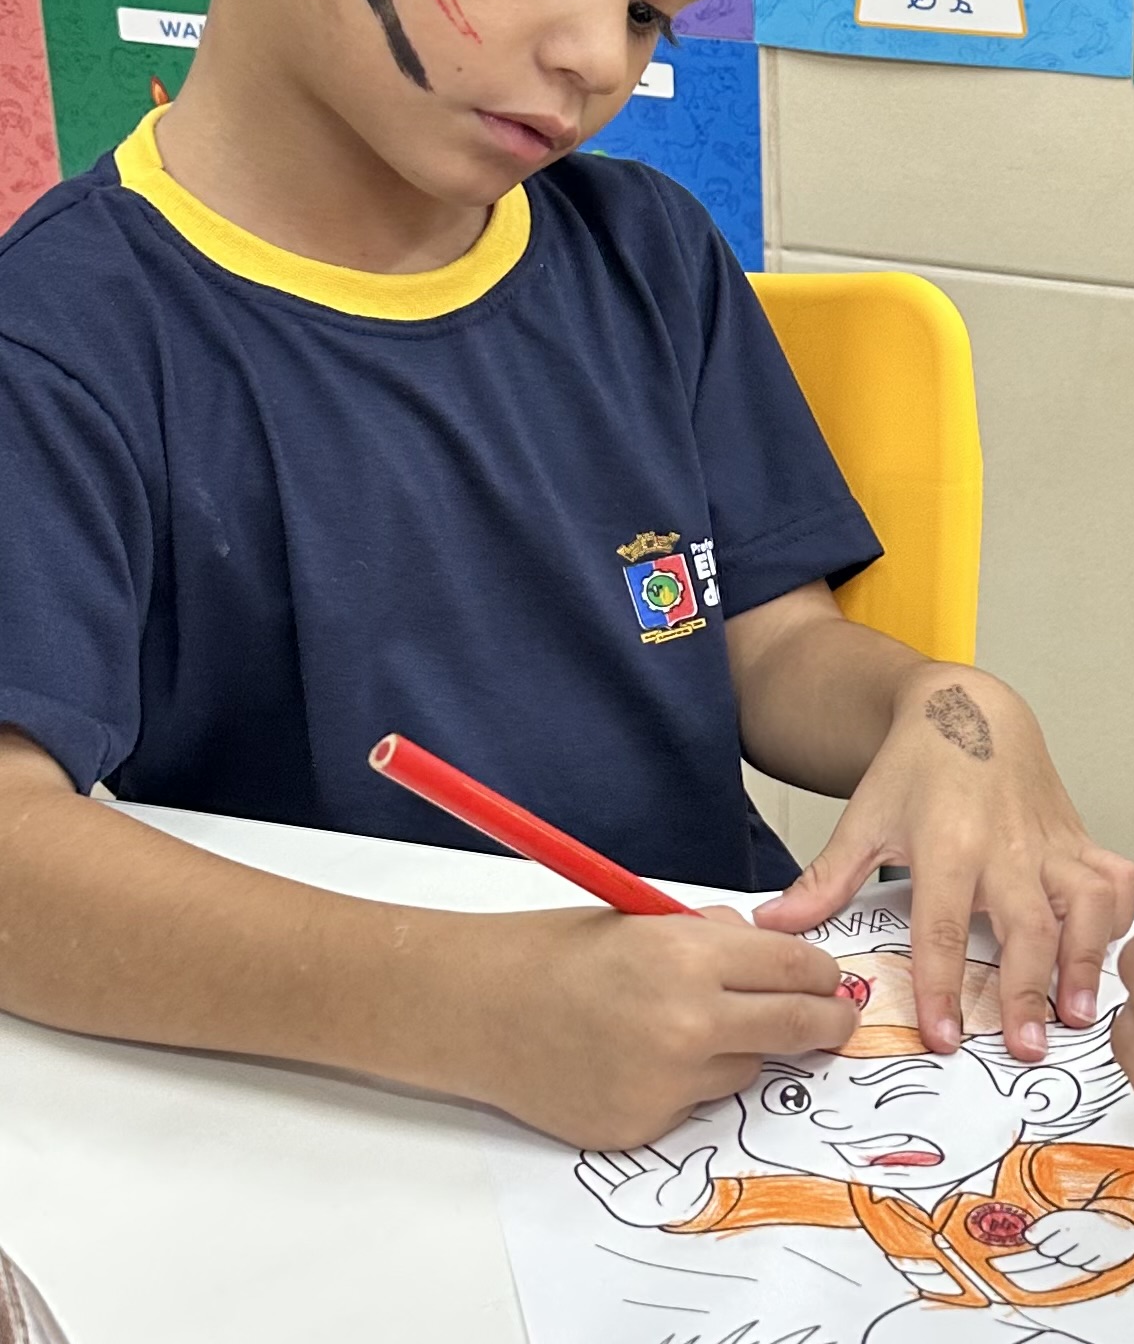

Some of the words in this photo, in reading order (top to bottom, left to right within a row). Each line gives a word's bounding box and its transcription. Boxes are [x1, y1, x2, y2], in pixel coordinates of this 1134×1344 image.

[690, 537, 714, 555] Prefe
[694, 549, 716, 580] El
[704, 578, 721, 607] d
